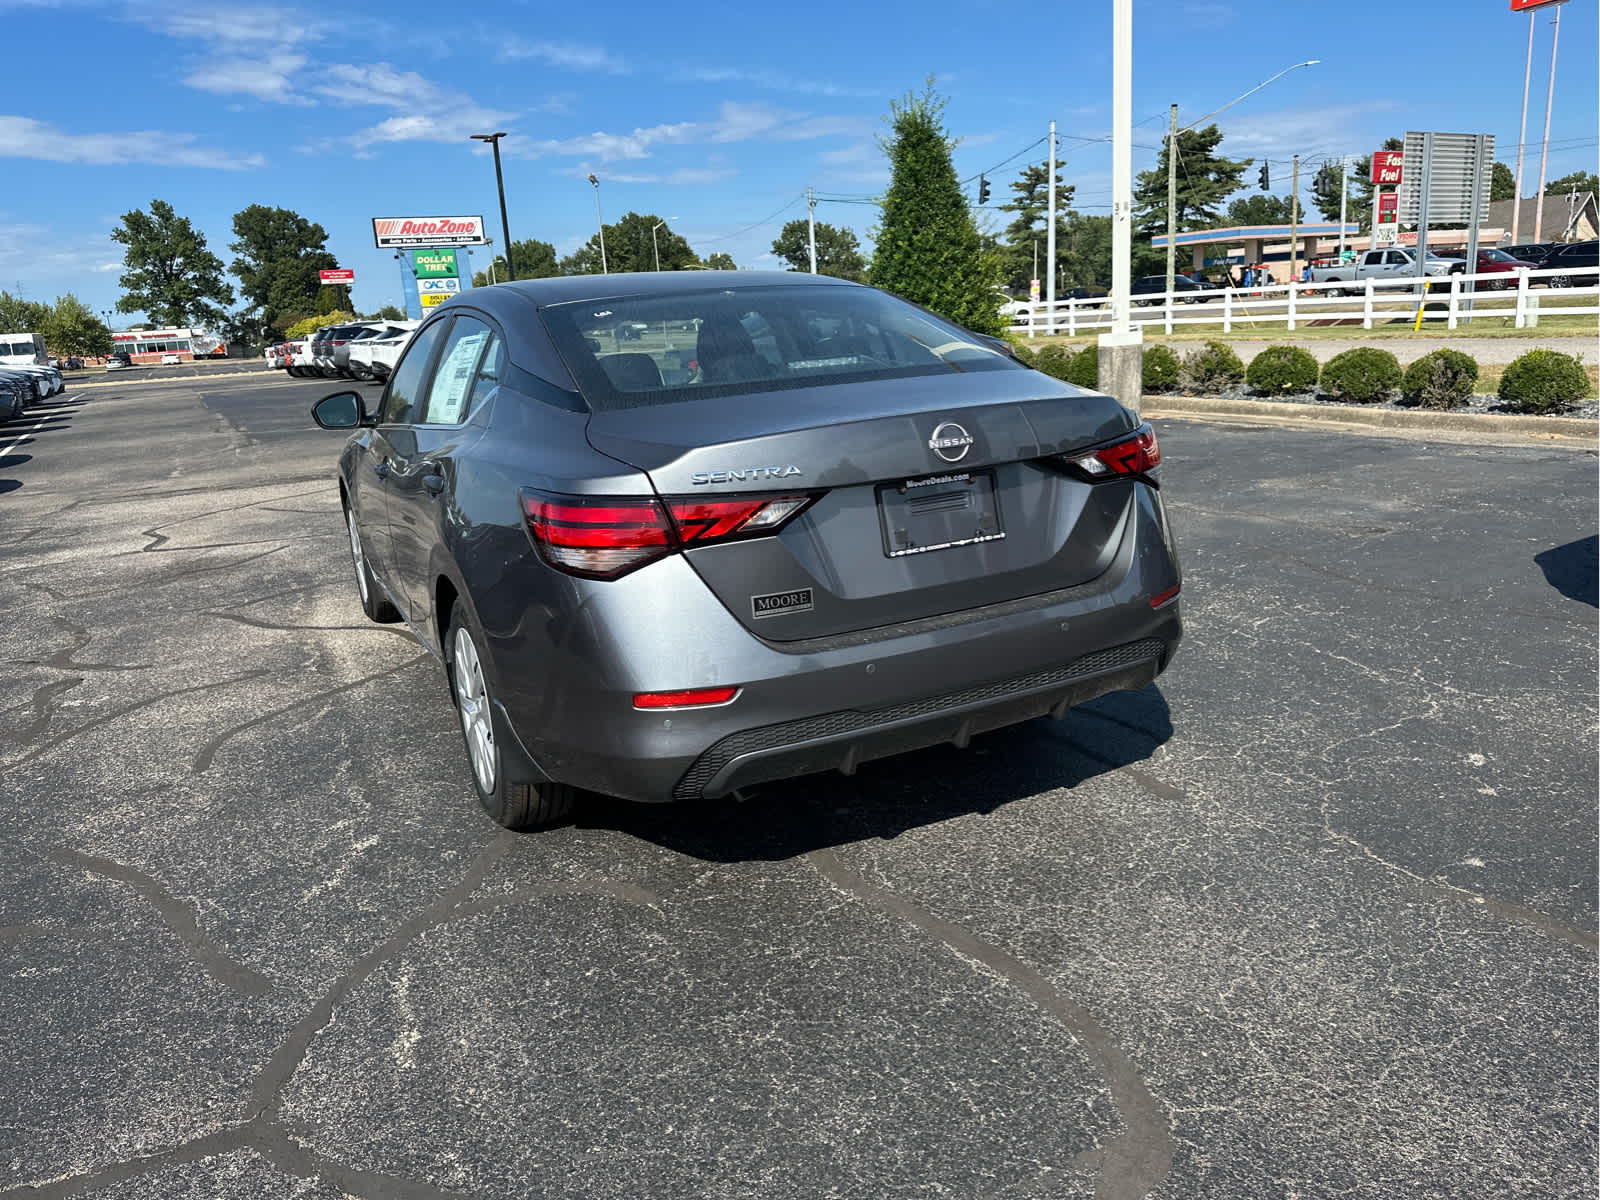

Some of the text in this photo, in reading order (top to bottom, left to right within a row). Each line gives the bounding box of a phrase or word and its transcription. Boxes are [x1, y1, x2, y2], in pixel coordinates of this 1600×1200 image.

[1386, 154, 1402, 166] Fas
[1380, 169, 1399, 181] Fuel
[400, 220, 475, 235] AutoZone
[417, 256, 453, 264] DOLLAR
[425, 264, 448, 272] TREE
[929, 436, 973, 449] NISSAN
[691, 465, 802, 485] SENTRA
[906, 473, 969, 488] MooreDeals.com
[758, 592, 809, 610] MOORE
